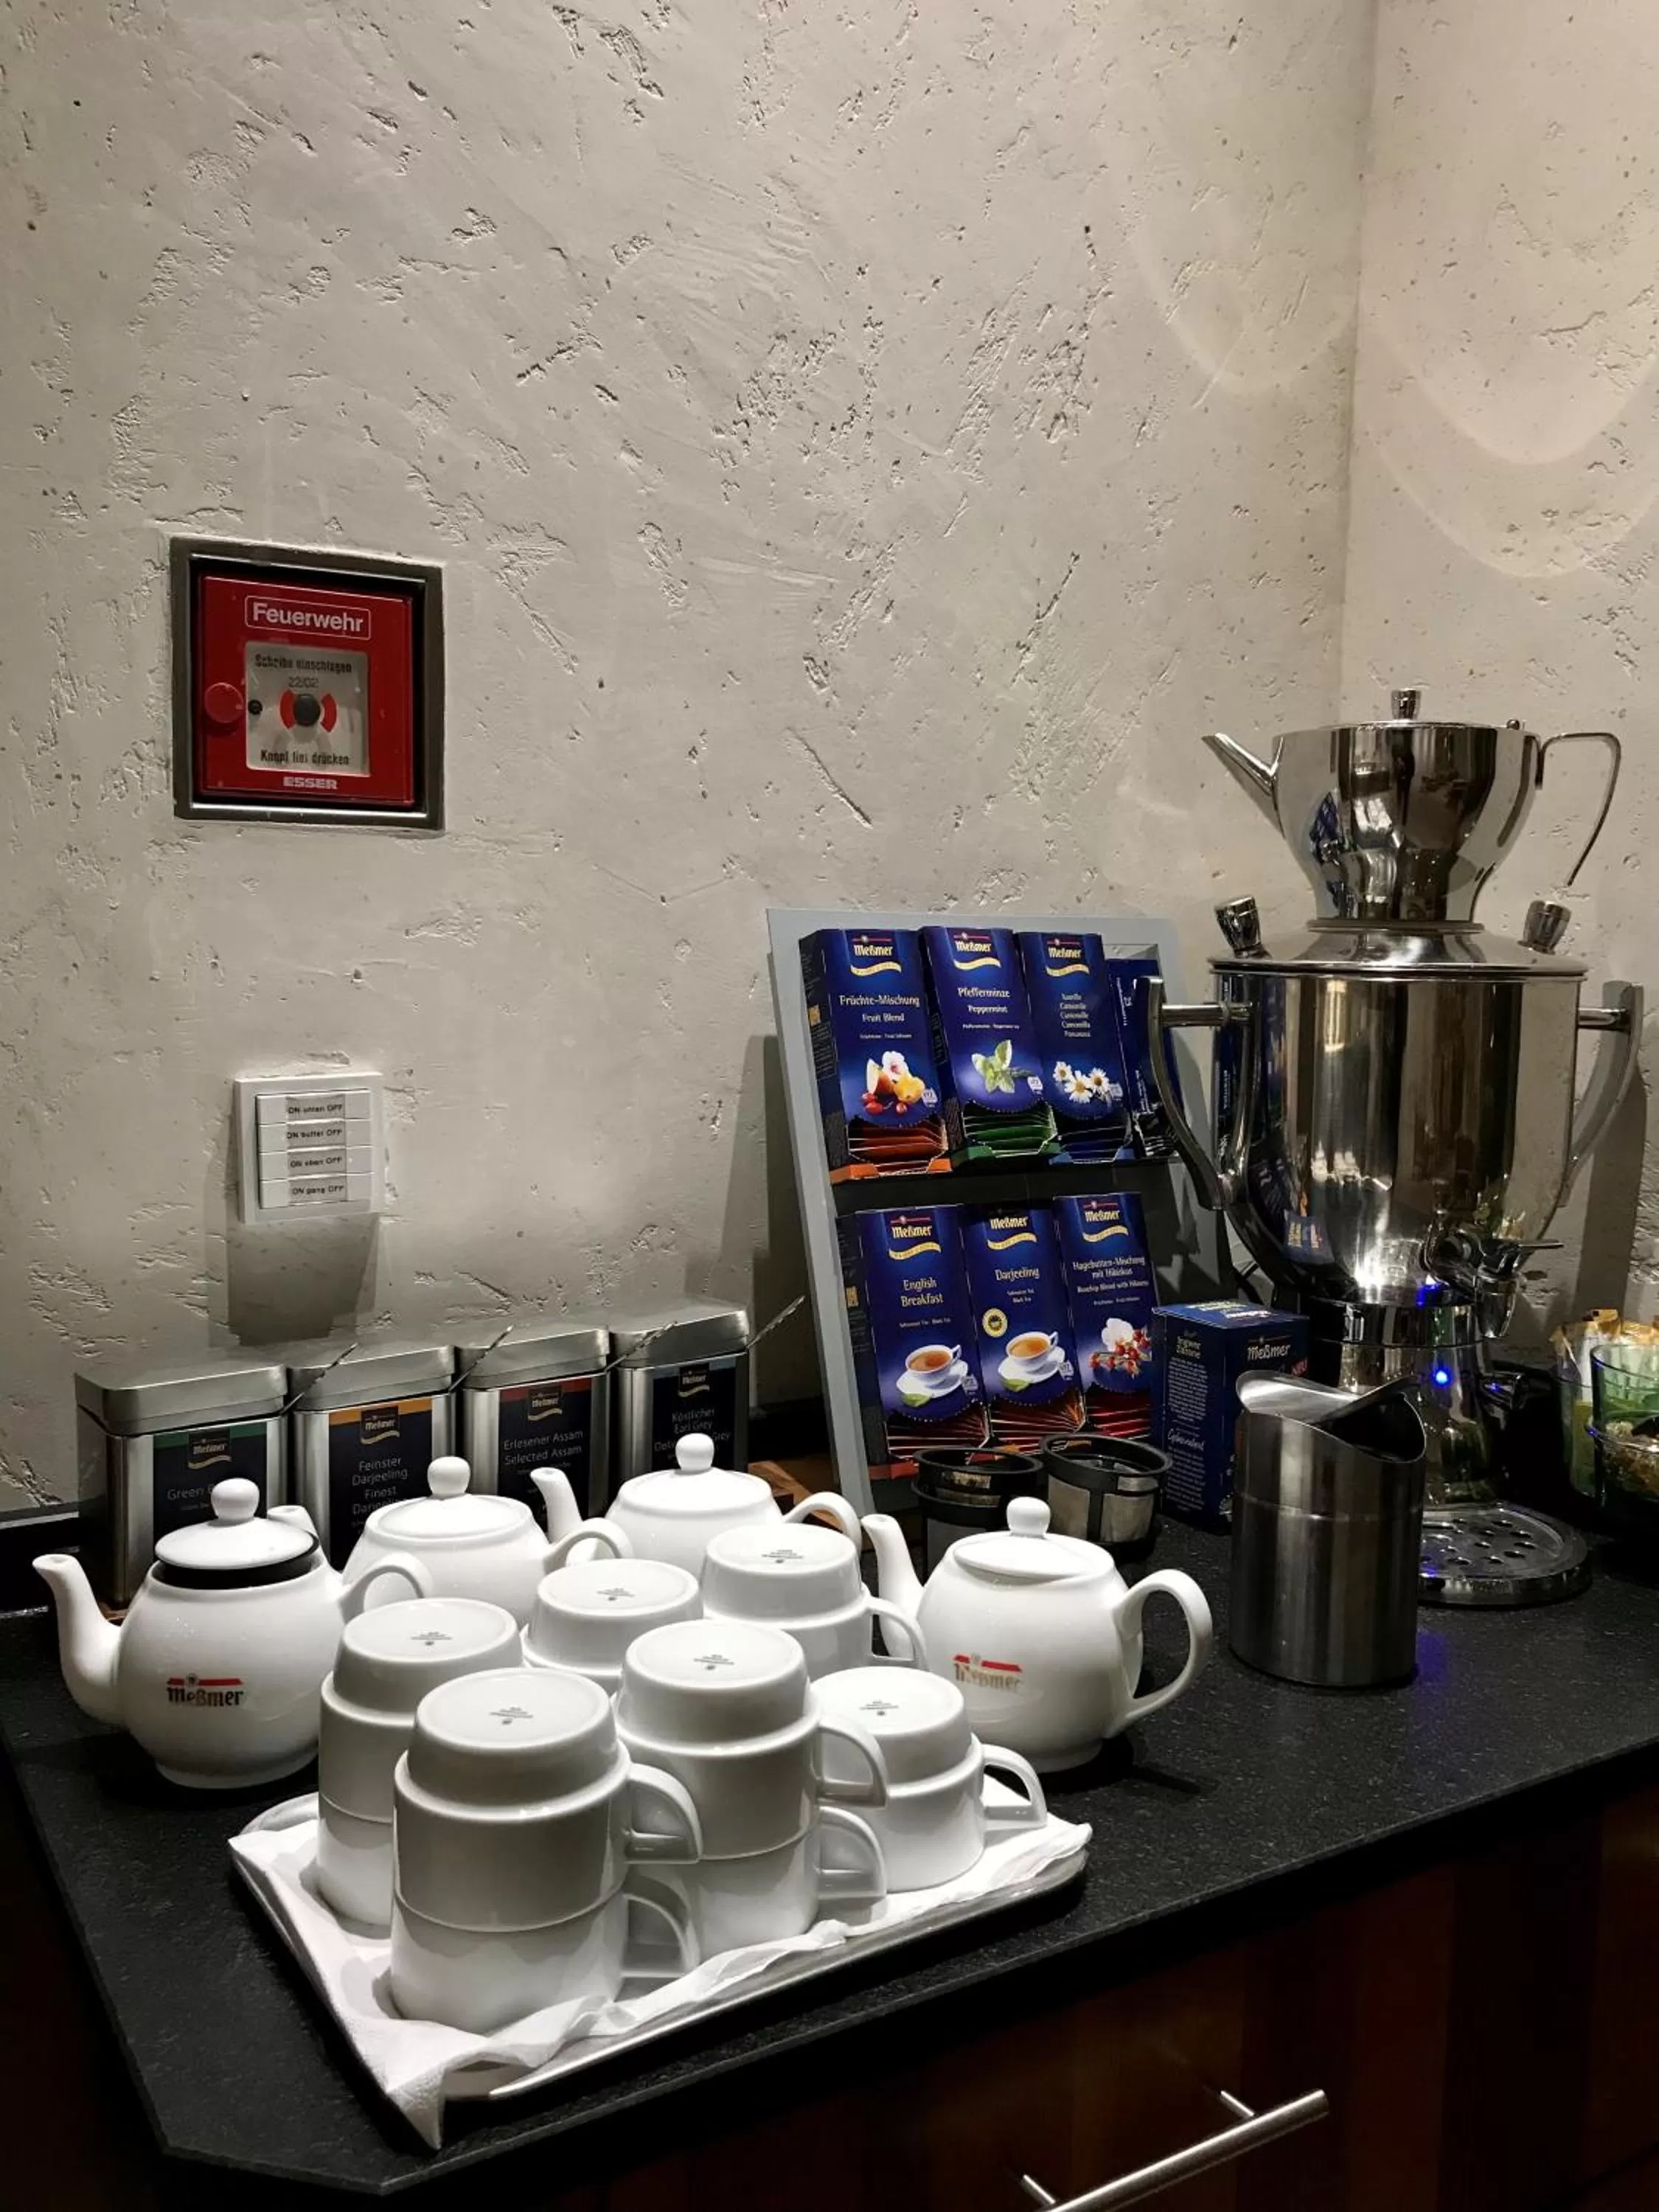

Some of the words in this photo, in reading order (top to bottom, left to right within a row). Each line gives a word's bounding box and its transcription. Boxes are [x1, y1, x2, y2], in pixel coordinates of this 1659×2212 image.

[253, 602, 364, 632] Feuerwehr
[283, 776, 338, 790] ESSER
[957, 987, 1010, 998] Pfefferminze
[839, 994, 920, 1007] Früchte-Mischung
[883, 1012, 905, 1022] Blend
[995, 1267, 1040, 1282] Darjeeling
[903, 1277, 937, 1293] English
[900, 1293, 944, 1307] Breakfast
[1247, 1344, 1291, 1361] Meßmer
[504, 1434, 549, 1451] Erlesener
[552, 1429, 585, 1444] Assam
[504, 1449, 549, 1465] Selected
[551, 1444, 582, 1458] Assam
[358, 1456, 402, 1472] Feinster
[352, 1468, 408, 1486] Darjeeling
[167, 1486, 204, 1501] Green
[364, 1485, 398, 1500] Finest
[166, 1686, 244, 1708] Meßmer
